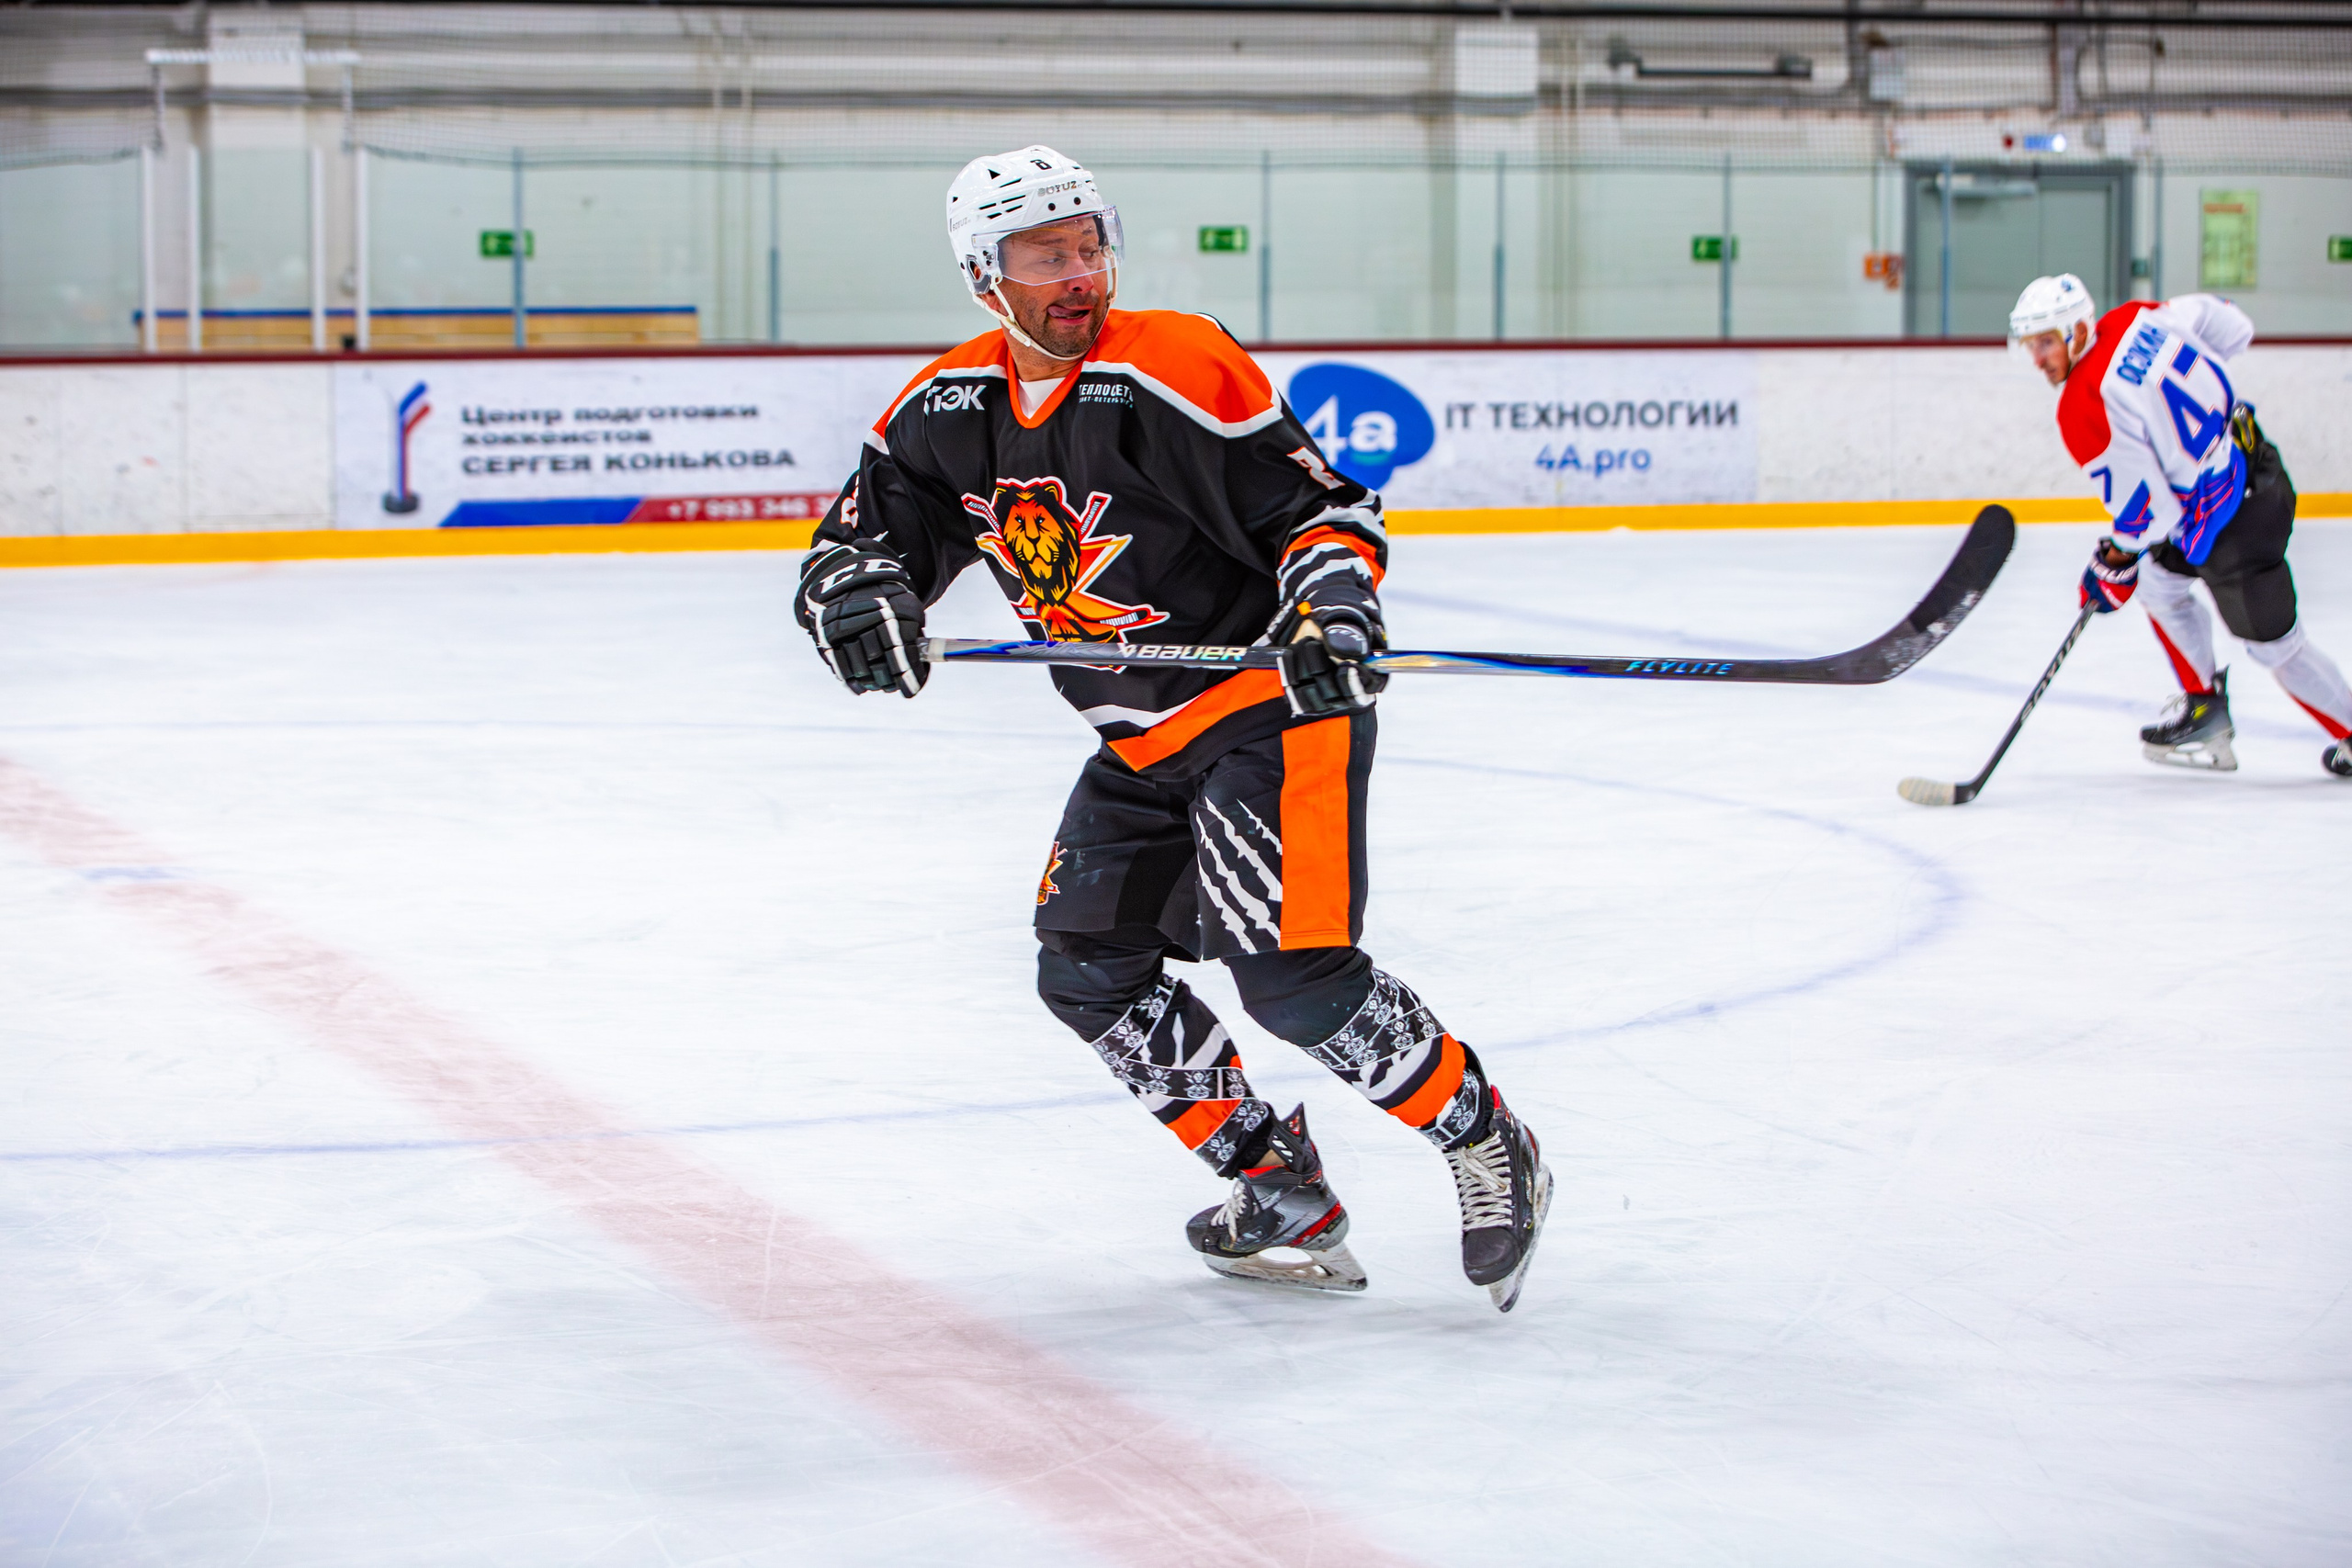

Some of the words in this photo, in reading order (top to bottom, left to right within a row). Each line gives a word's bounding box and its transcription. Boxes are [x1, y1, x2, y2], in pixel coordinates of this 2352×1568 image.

[461, 406, 562, 427] Центр
[573, 404, 759, 423] подготовки
[1445, 400, 1475, 429] IT
[1487, 399, 1740, 429] ТЕХНОЛОГИИ
[2157, 340, 2235, 464] 47
[461, 429, 653, 446] хоккеистов
[1301, 393, 1398, 468] 4a
[461, 454, 593, 475] СЕРГЕЯ
[603, 448, 797, 472] КОНЬКОВА
[1534, 443, 1653, 479] 4A.pro
[2090, 466, 2112, 503] 7
[820, 558, 911, 594] CC
[1136, 644, 1248, 661] BAUER
[1624, 660, 1735, 676] FLYLITE
